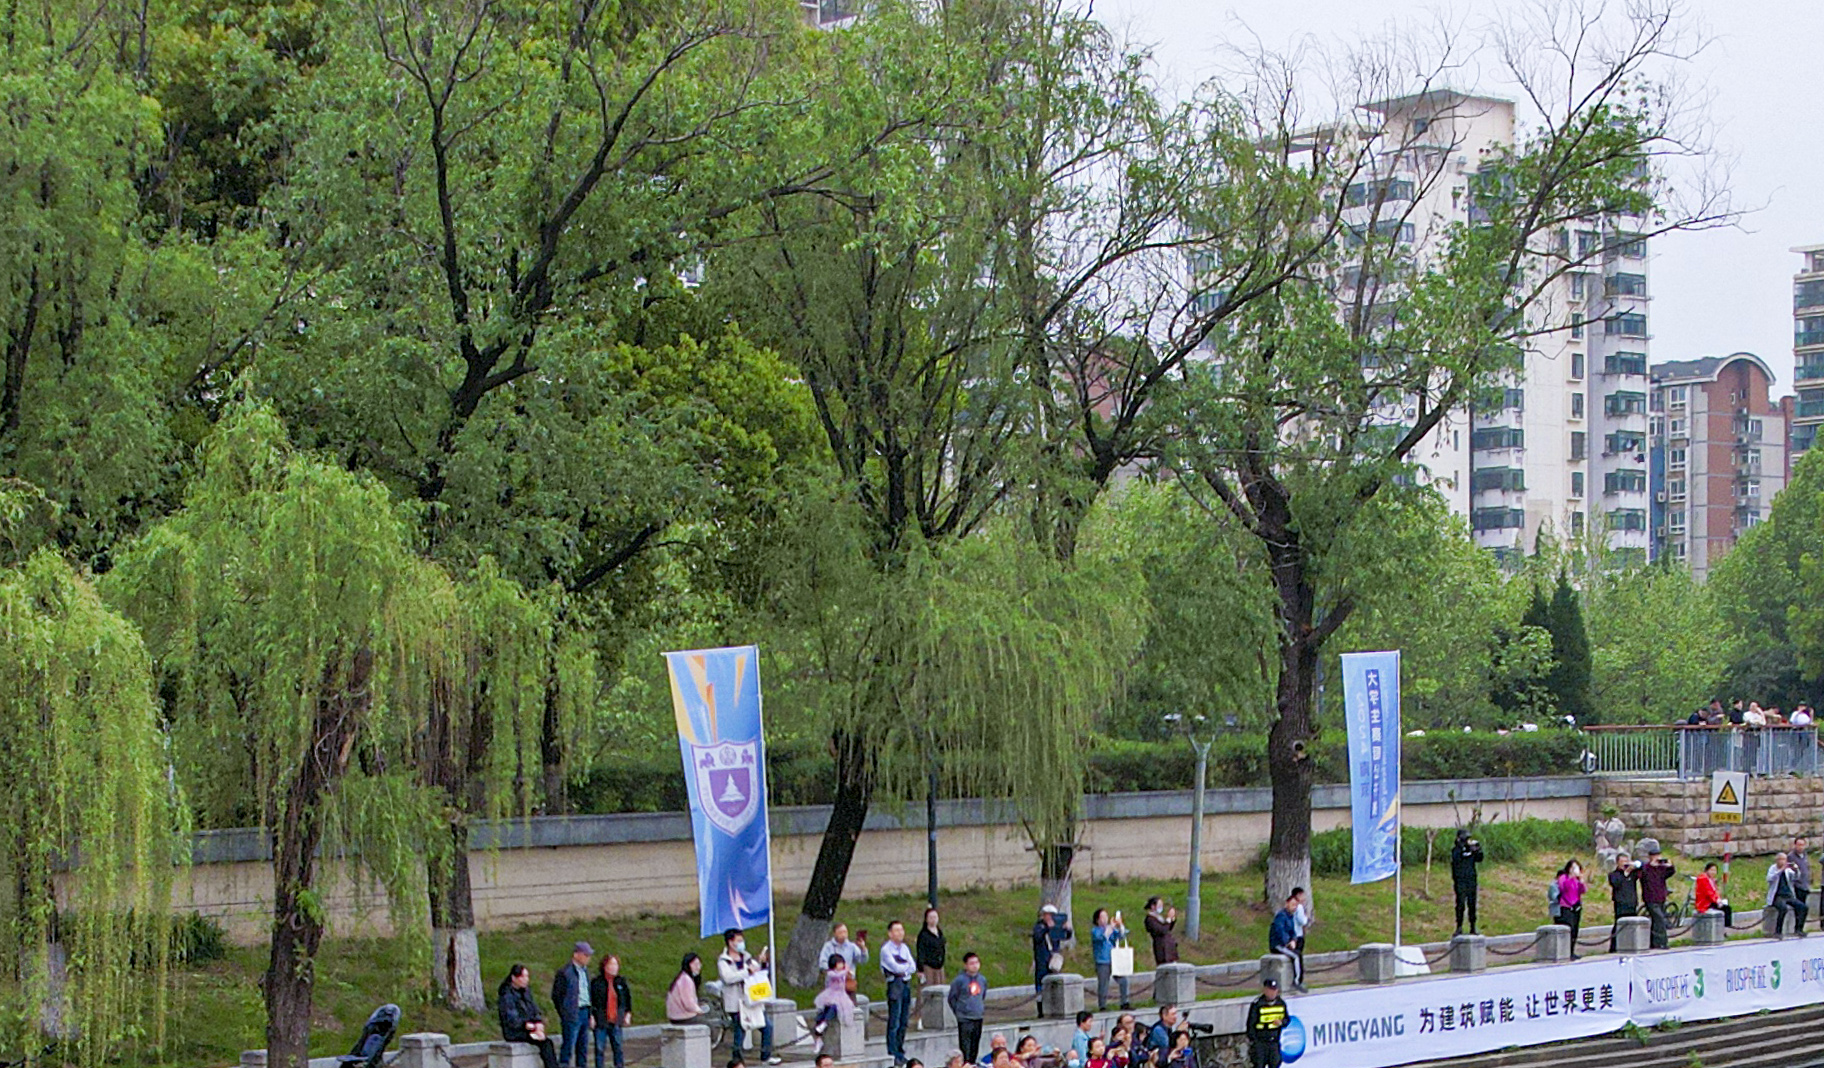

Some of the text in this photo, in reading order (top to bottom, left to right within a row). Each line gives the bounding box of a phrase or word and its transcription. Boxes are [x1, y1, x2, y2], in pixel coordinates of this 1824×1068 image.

[1726, 965, 1768, 993] BIOSPHERE
[1312, 1013, 1405, 1047] MINGYANG
[1418, 994, 1517, 1035] 为建筑赋能
